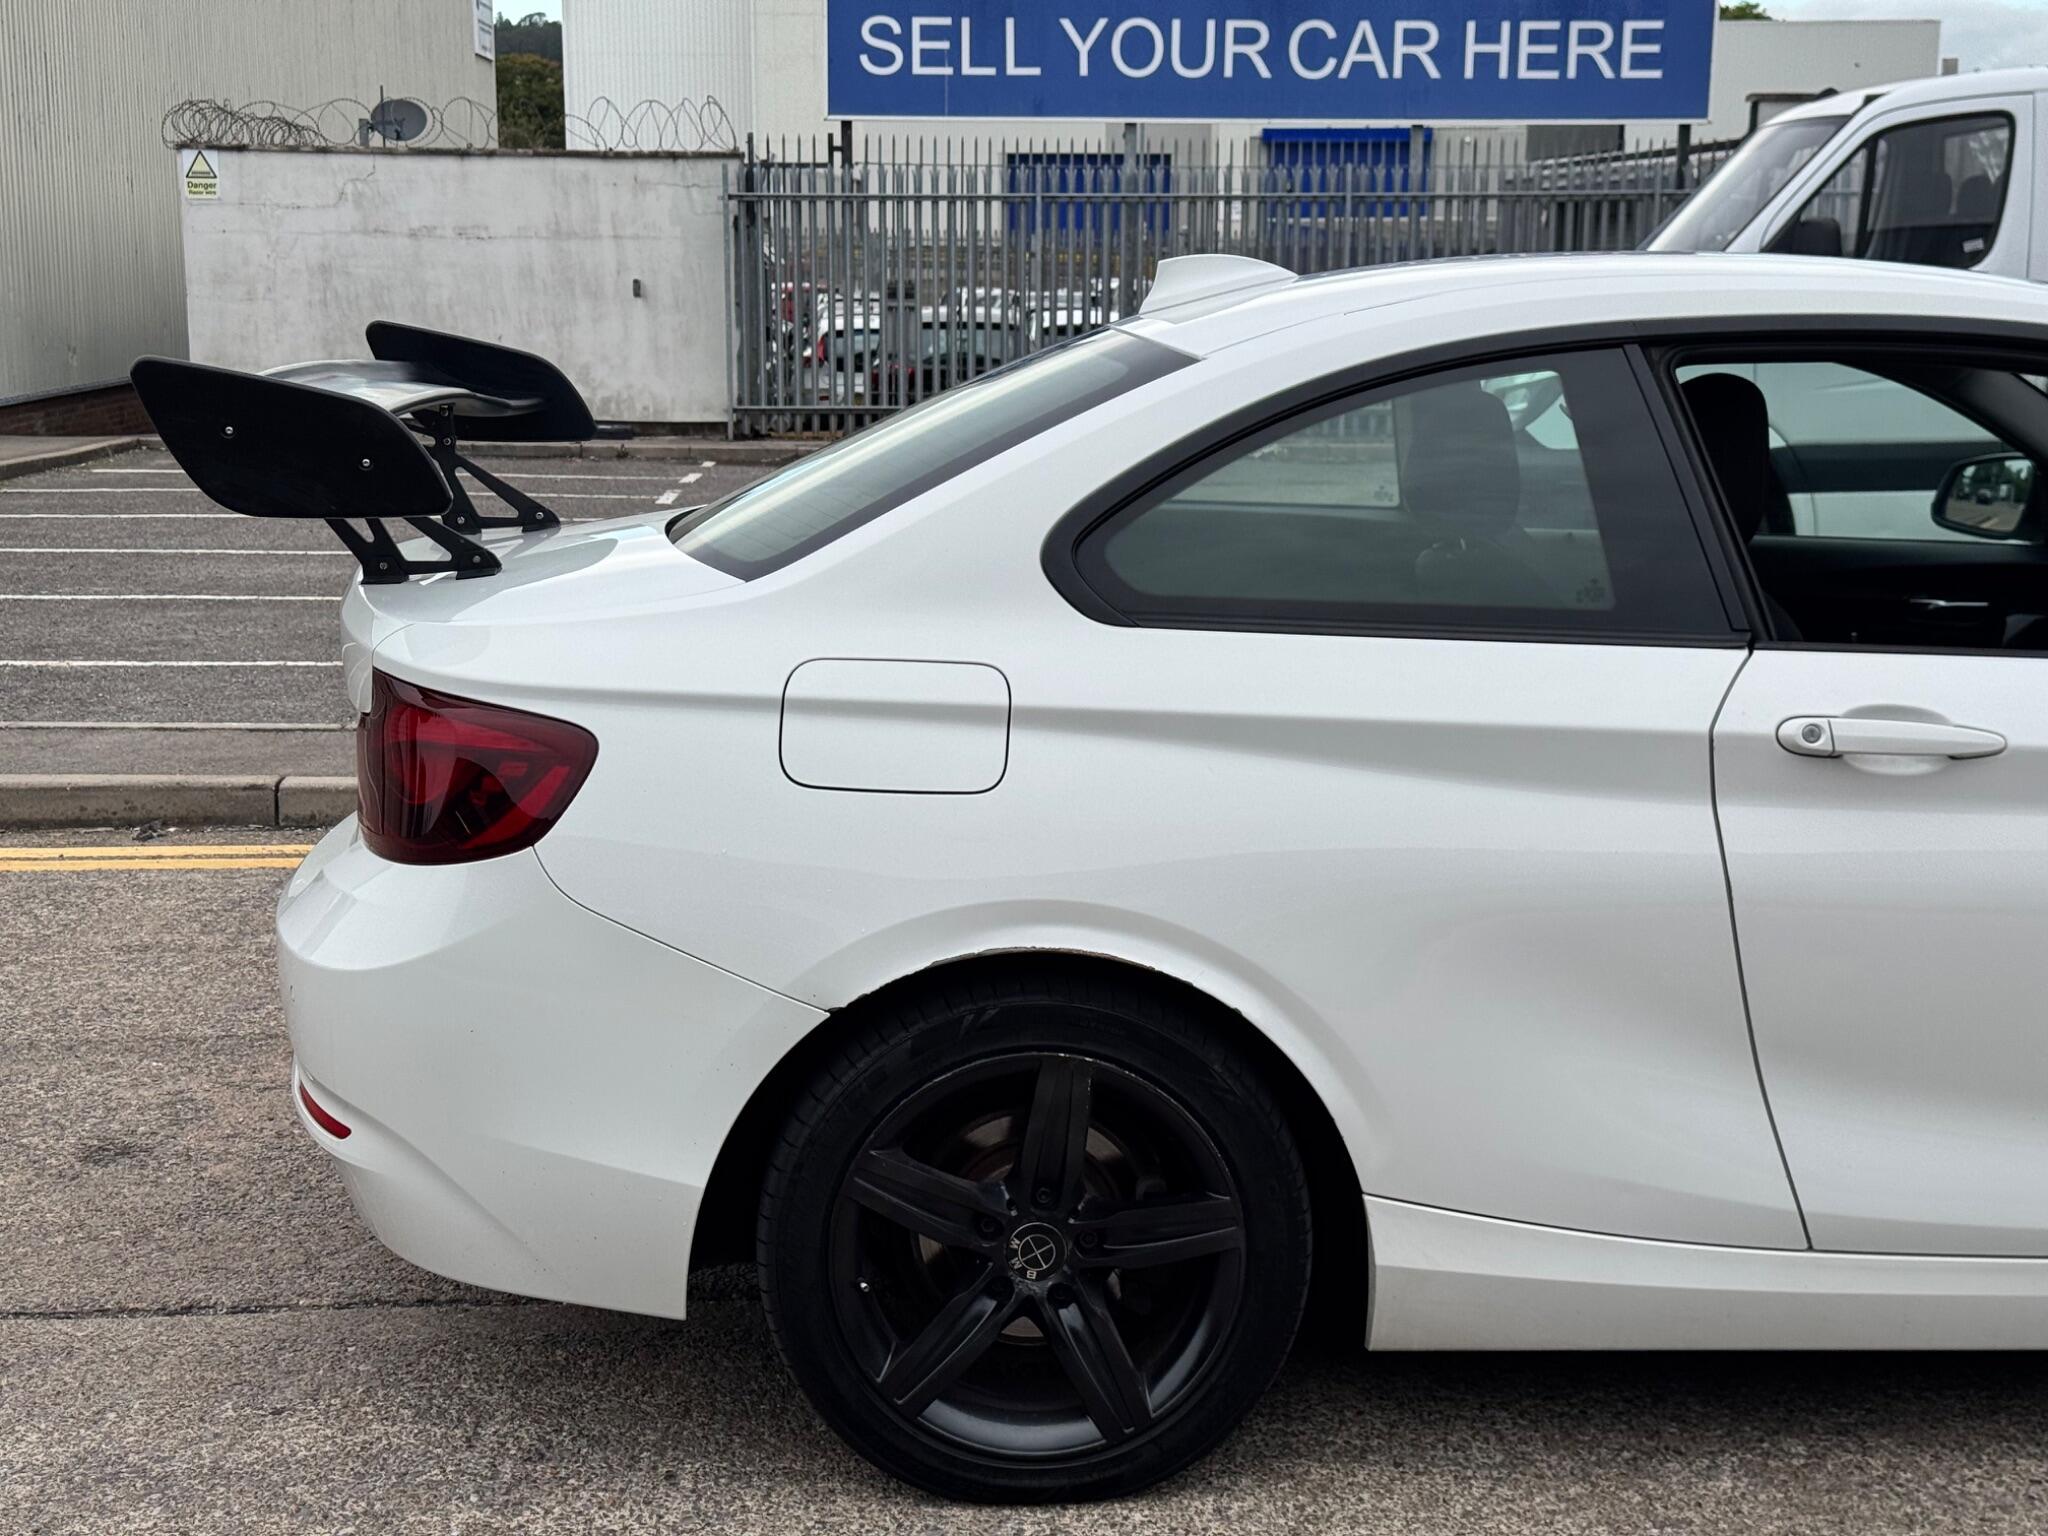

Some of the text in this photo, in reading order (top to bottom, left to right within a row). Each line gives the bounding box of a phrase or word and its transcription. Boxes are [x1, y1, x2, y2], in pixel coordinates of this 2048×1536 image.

[858, 14, 1666, 80] SELL YOUR CAR HERE
[187, 181, 217, 190] Danger
